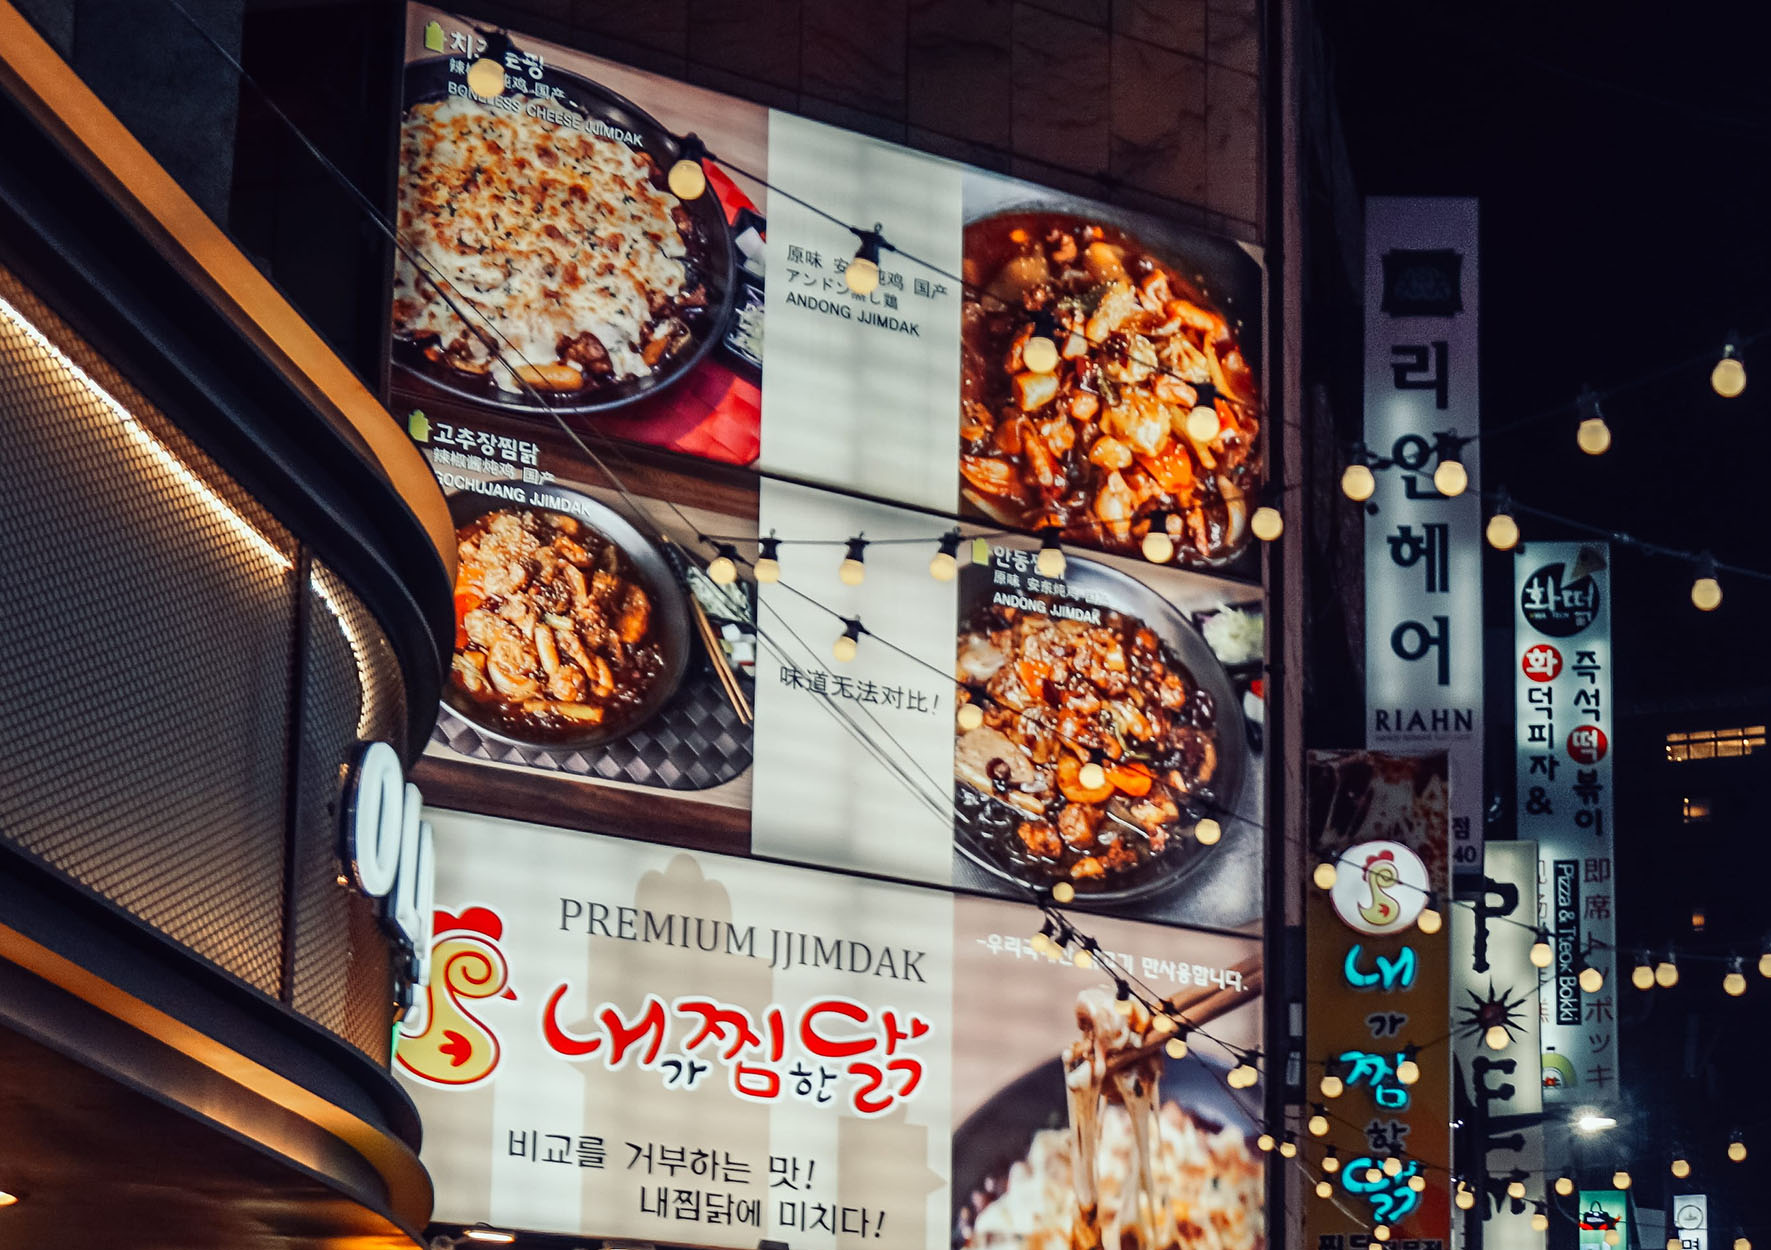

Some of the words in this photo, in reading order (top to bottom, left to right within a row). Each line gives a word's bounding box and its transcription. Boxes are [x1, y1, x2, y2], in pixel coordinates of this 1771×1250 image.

[525, 104, 581, 131] CHEESE
[584, 119, 644, 147] JJIMDAK
[786, 268, 898, 310] アンドンし鶏
[787, 245, 823, 268] 原味
[914, 278, 948, 299] 国产
[786, 292, 850, 319] ANDONG
[857, 311, 921, 337] JJIMDAK
[433, 423, 540, 466] 고추장찜닭
[435, 471, 526, 502] GOCHUJANG
[530, 492, 590, 517] JJIMDAK
[993, 592, 1046, 614] ANDONG
[1050, 604, 1101, 624] JJIMDAK
[780, 665, 939, 714] 味道无法对比!
[1375, 709, 1473, 733] RIAHN
[1557, 864, 1575, 907] Pizza
[1558, 911, 1575, 923] &
[559, 898, 756, 957] PREMIUM
[768, 929, 927, 983] JJIMDAK
[1560, 976, 1578, 1021] Bokki
[542, 983, 929, 1113] 내가찜한닭
[508, 1129, 607, 1169] 비교를
[626, 1141, 751, 1184] 거부하는
[769, 1155, 816, 1191] 맛!
[640, 1185, 761, 1228] 내찜닭에
[779, 1200, 886, 1239] 미치다!
